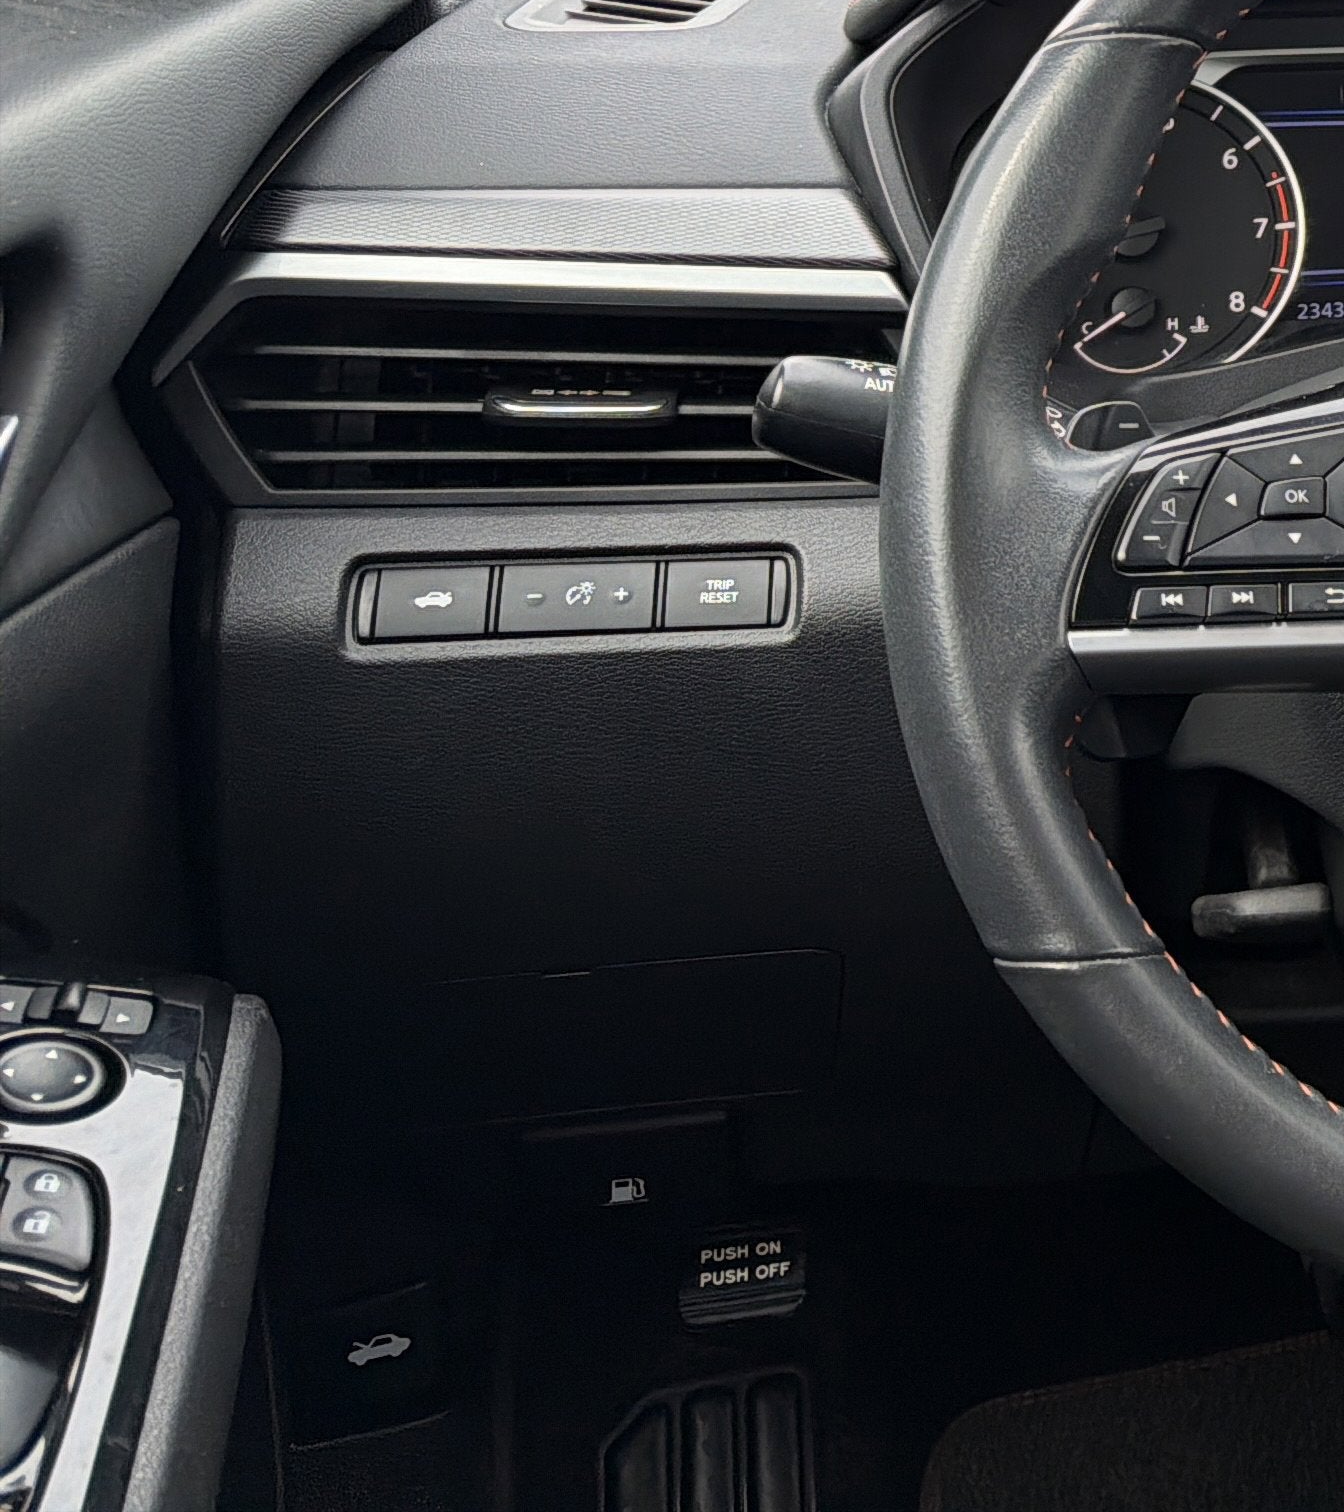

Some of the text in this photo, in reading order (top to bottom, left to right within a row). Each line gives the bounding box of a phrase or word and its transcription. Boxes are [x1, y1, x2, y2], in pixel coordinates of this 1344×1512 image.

[1222, 148, 1239, 170] 6
[1252, 217, 1269, 239] 7
[1229, 291, 1246, 313] 8
[1166, 317, 1179, 330] H
[864, 376, 895, 393] AUT
[1284, 489, 1310, 504] OK
[706, 578, 735, 591] TRIP
[699, 591, 740, 604] RESET
[700, 1239, 781, 1264] PUSH ON
[700, 1261, 791, 1288] PUSH OFF
